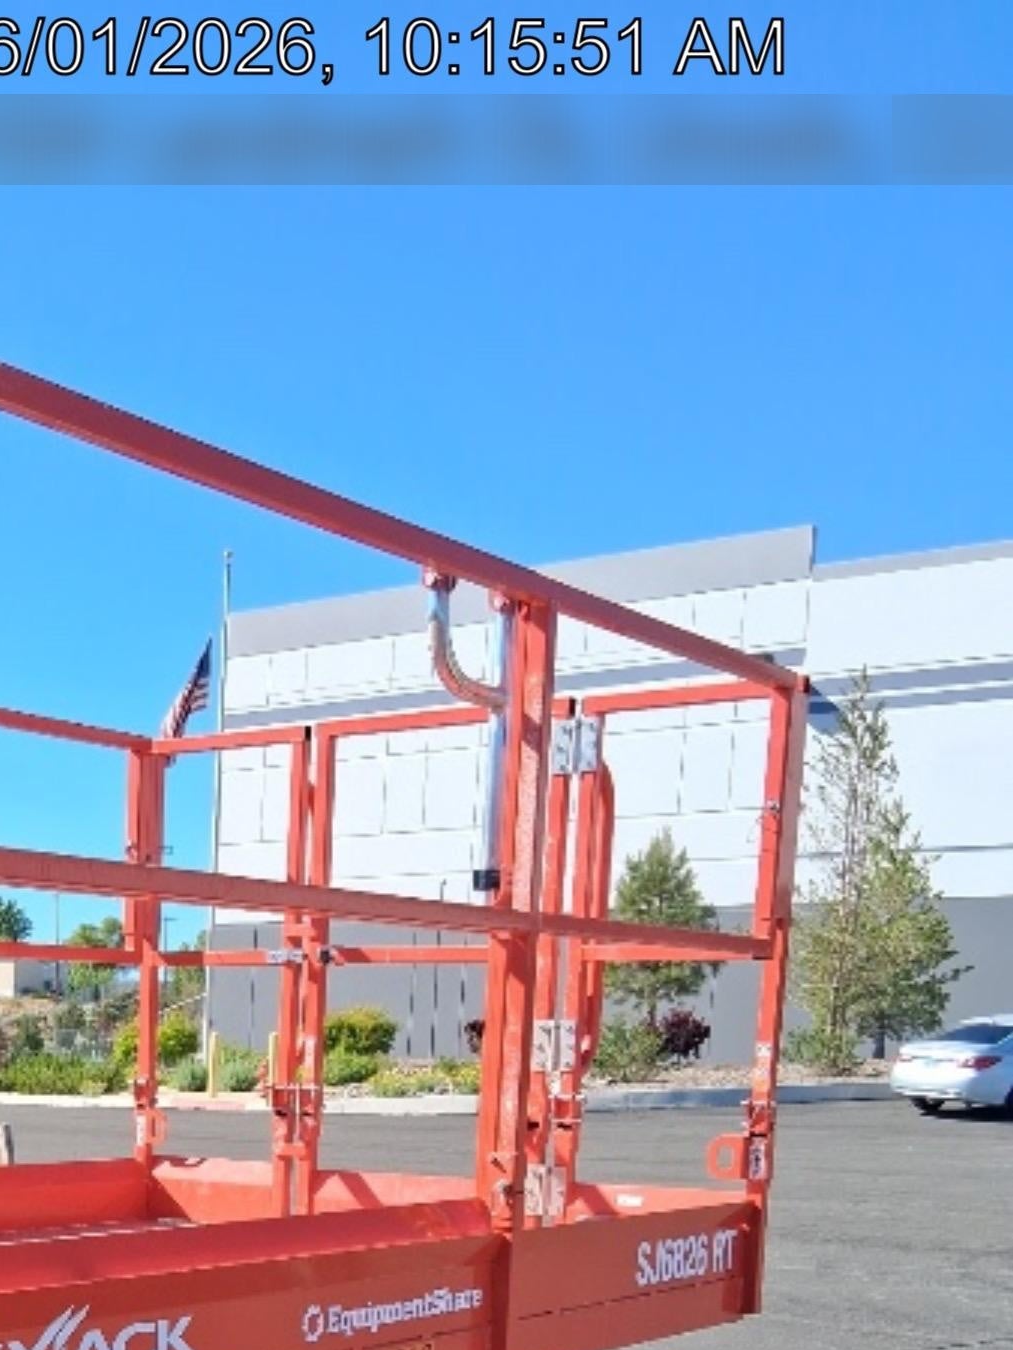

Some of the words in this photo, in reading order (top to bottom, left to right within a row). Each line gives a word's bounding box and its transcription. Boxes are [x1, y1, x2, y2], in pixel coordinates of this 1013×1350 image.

[636, 1232, 708, 1286] SJ6826
[713, 1229, 738, 1273] RT
[328, 1286, 484, 1336] EquipmentShare
